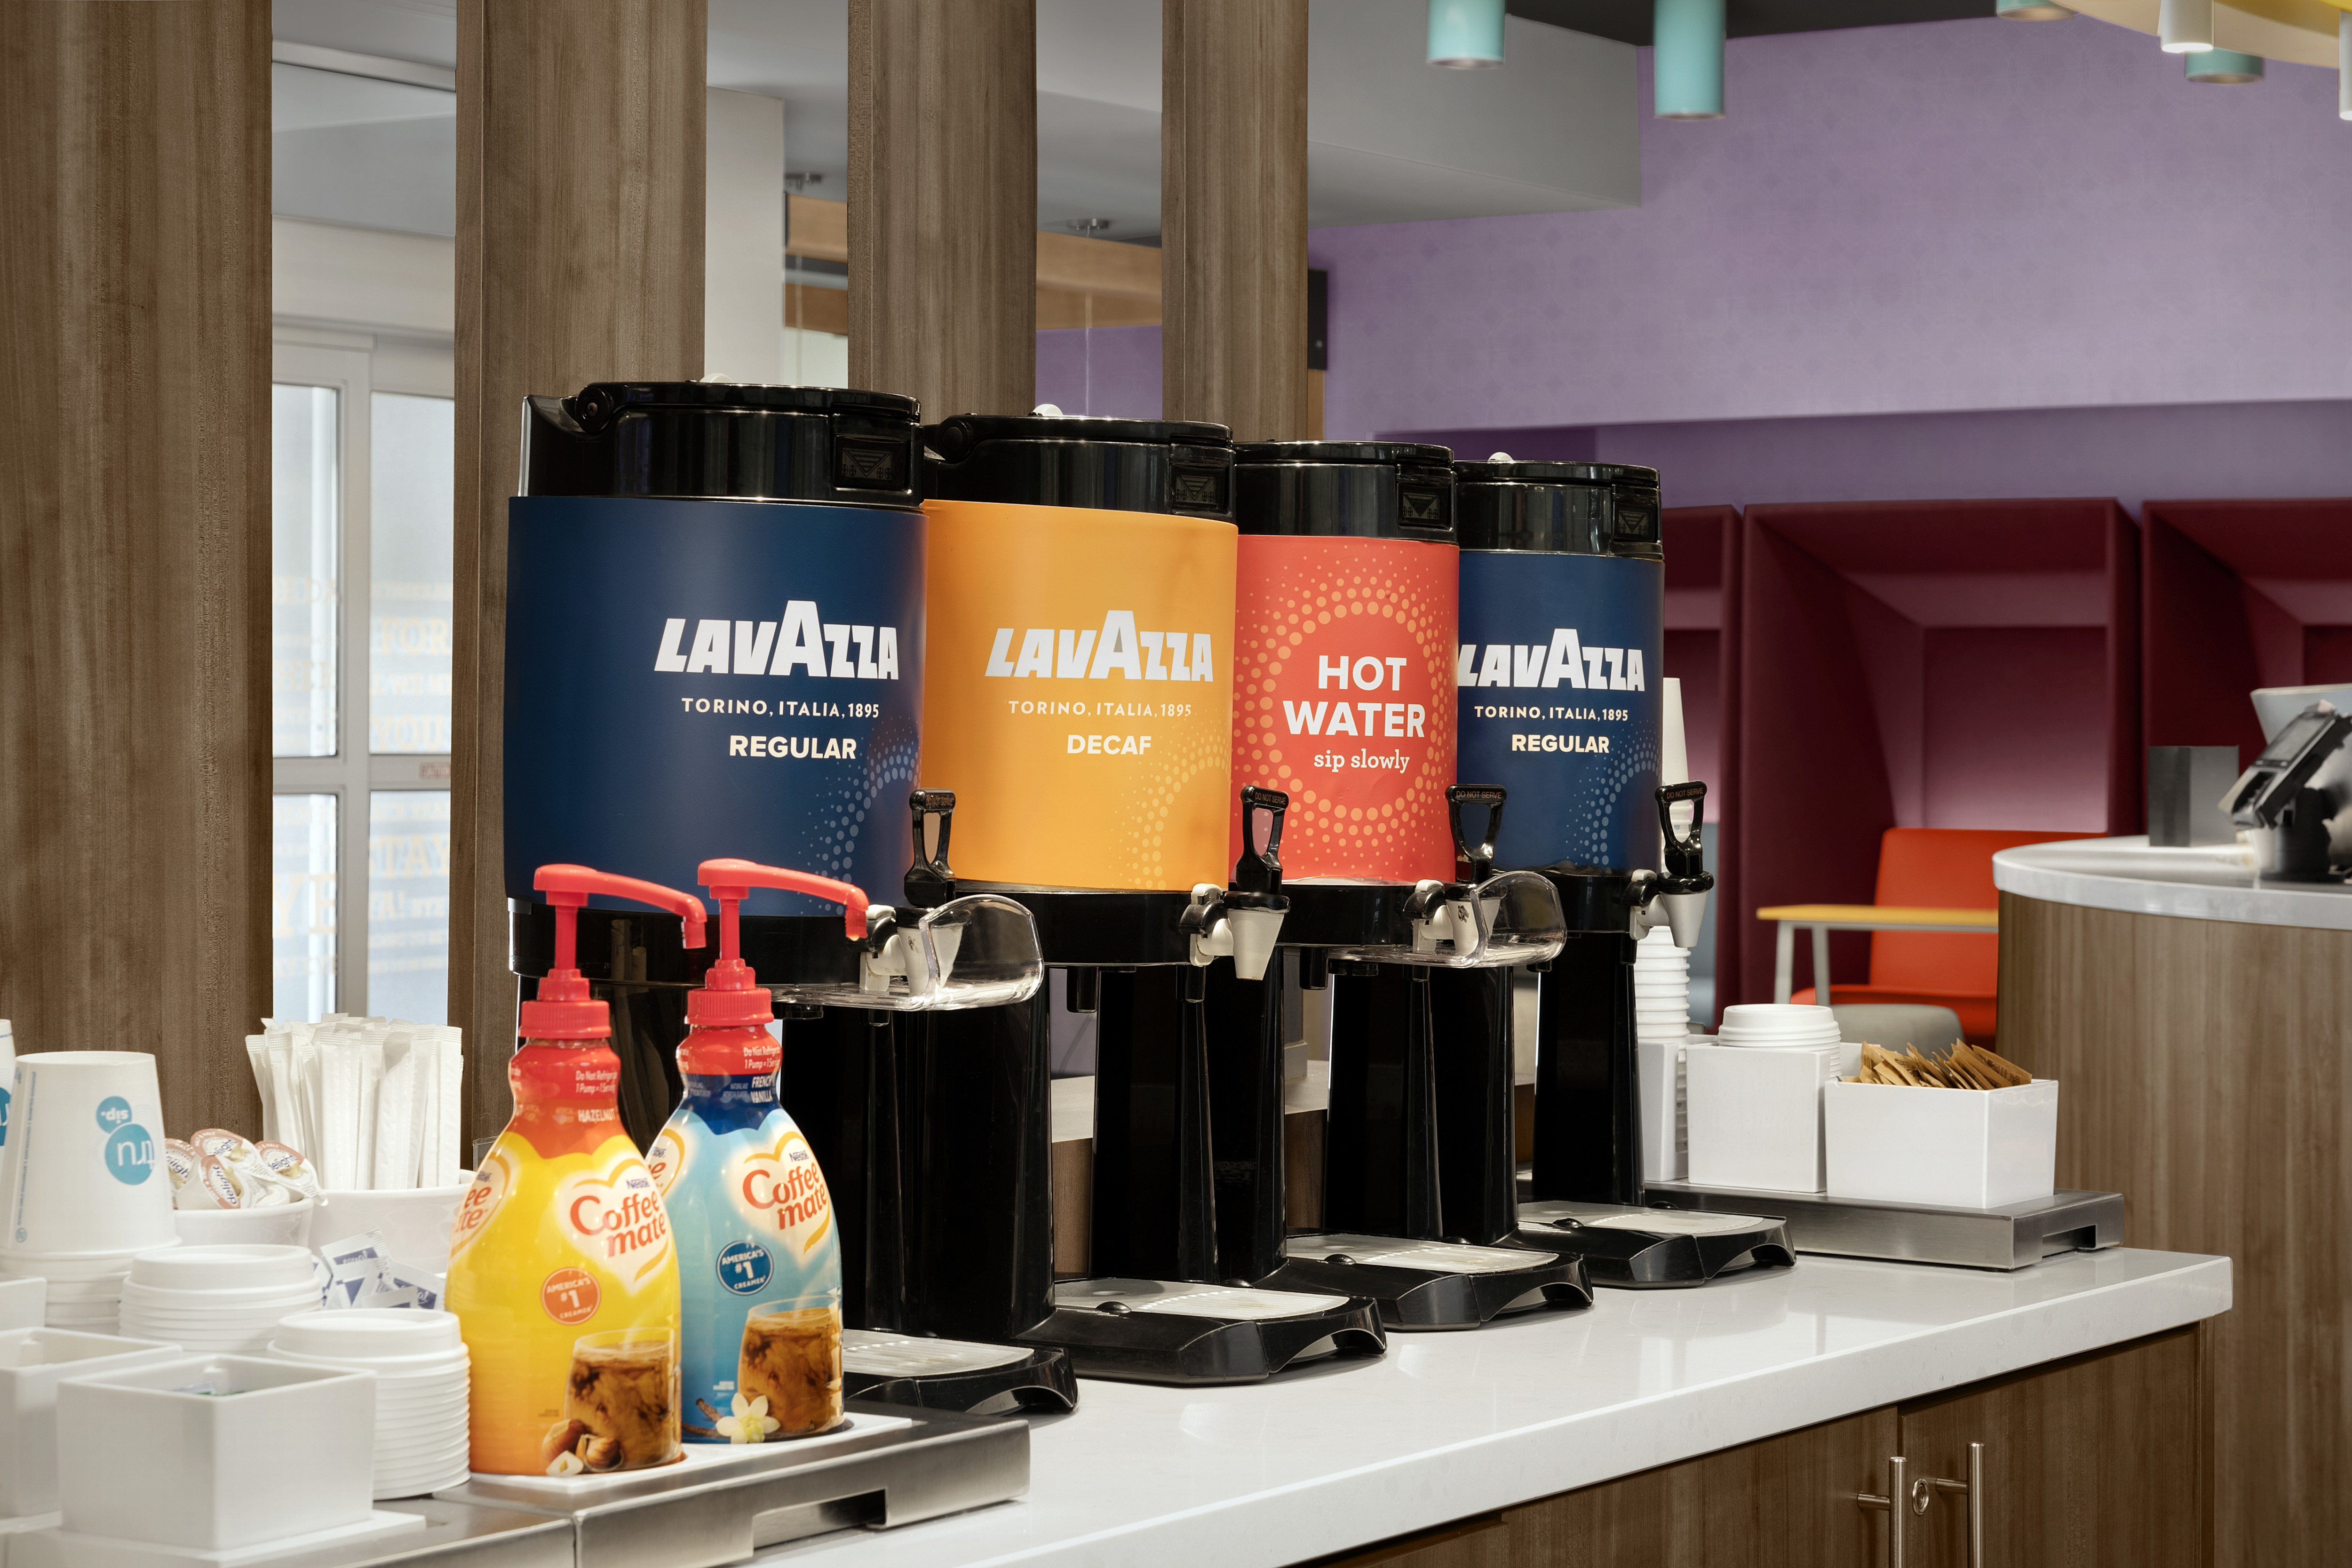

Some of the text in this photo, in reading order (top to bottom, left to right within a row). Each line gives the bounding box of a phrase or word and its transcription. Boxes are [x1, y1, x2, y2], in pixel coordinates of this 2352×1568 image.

[654, 600, 898, 679] LAVAZZA
[985, 610, 1213, 682] LAVAZZA
[1458, 629, 1645, 692] LAVAZZA
[1318, 655, 1406, 691] HOT
[682, 697, 879, 719] TORINO, ITALIA, 1895
[1009, 700, 1192, 718] TORINO, ITALIA, 1895
[1283, 701, 1425, 738] WATER
[1474, 706, 1628, 722] TORINO, ITALIA, 1895
[730, 735, 857, 759] REGULAR
[1067, 734, 1152, 755] DECAF
[1512, 734, 1609, 753] REGULAR
[1314, 748, 1410, 773] sip slowly
[1262, 794, 1271, 802] NOT
[1272, 795, 1286, 805] SERVE
[750, 1090, 773, 1103] VANILLA
[578, 1108, 616, 1122] HAZELNUT
[743, 1162, 819, 1210] Coffee
[570, 1191, 659, 1236] Coffee
[777, 1184, 826, 1230] mate
[607, 1213, 666, 1258] mate
[722, 1249, 764, 1266] AMERICA'S
[735, 1261, 754, 1279] #1
[547, 1277, 591, 1293] AMERICA'S
